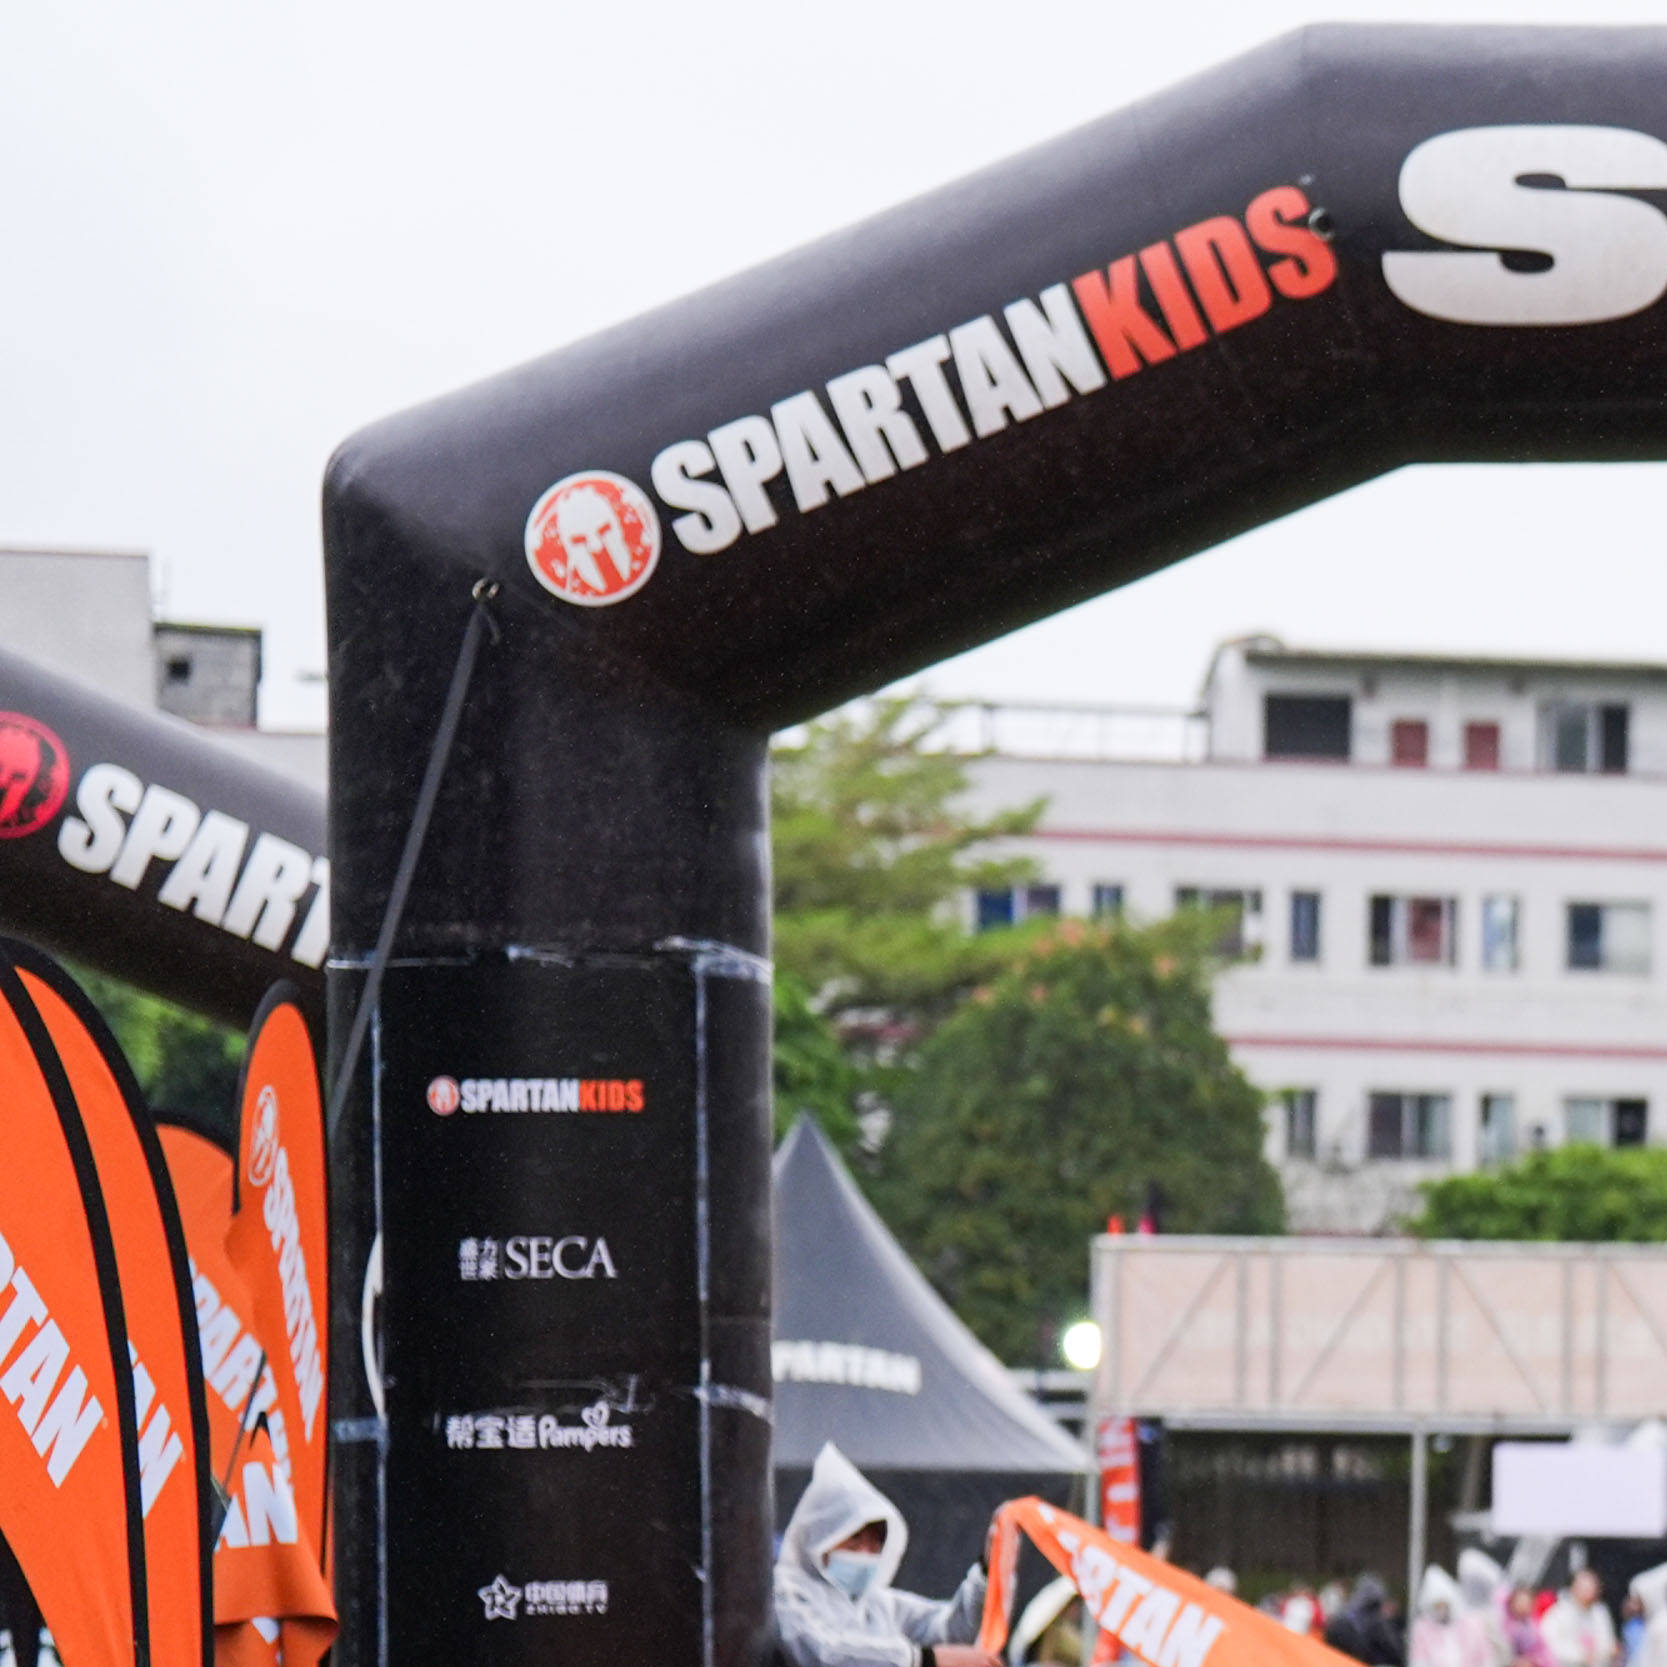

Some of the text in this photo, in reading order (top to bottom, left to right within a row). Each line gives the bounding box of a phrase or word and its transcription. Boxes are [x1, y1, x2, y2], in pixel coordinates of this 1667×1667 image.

[652, 186, 1337, 557] SPARTANKIDS
[461, 1079, 643, 1113] SPARTANKIDS
[504, 1235, 618, 1280] SECA
[538, 1403, 635, 1452] Pampers
